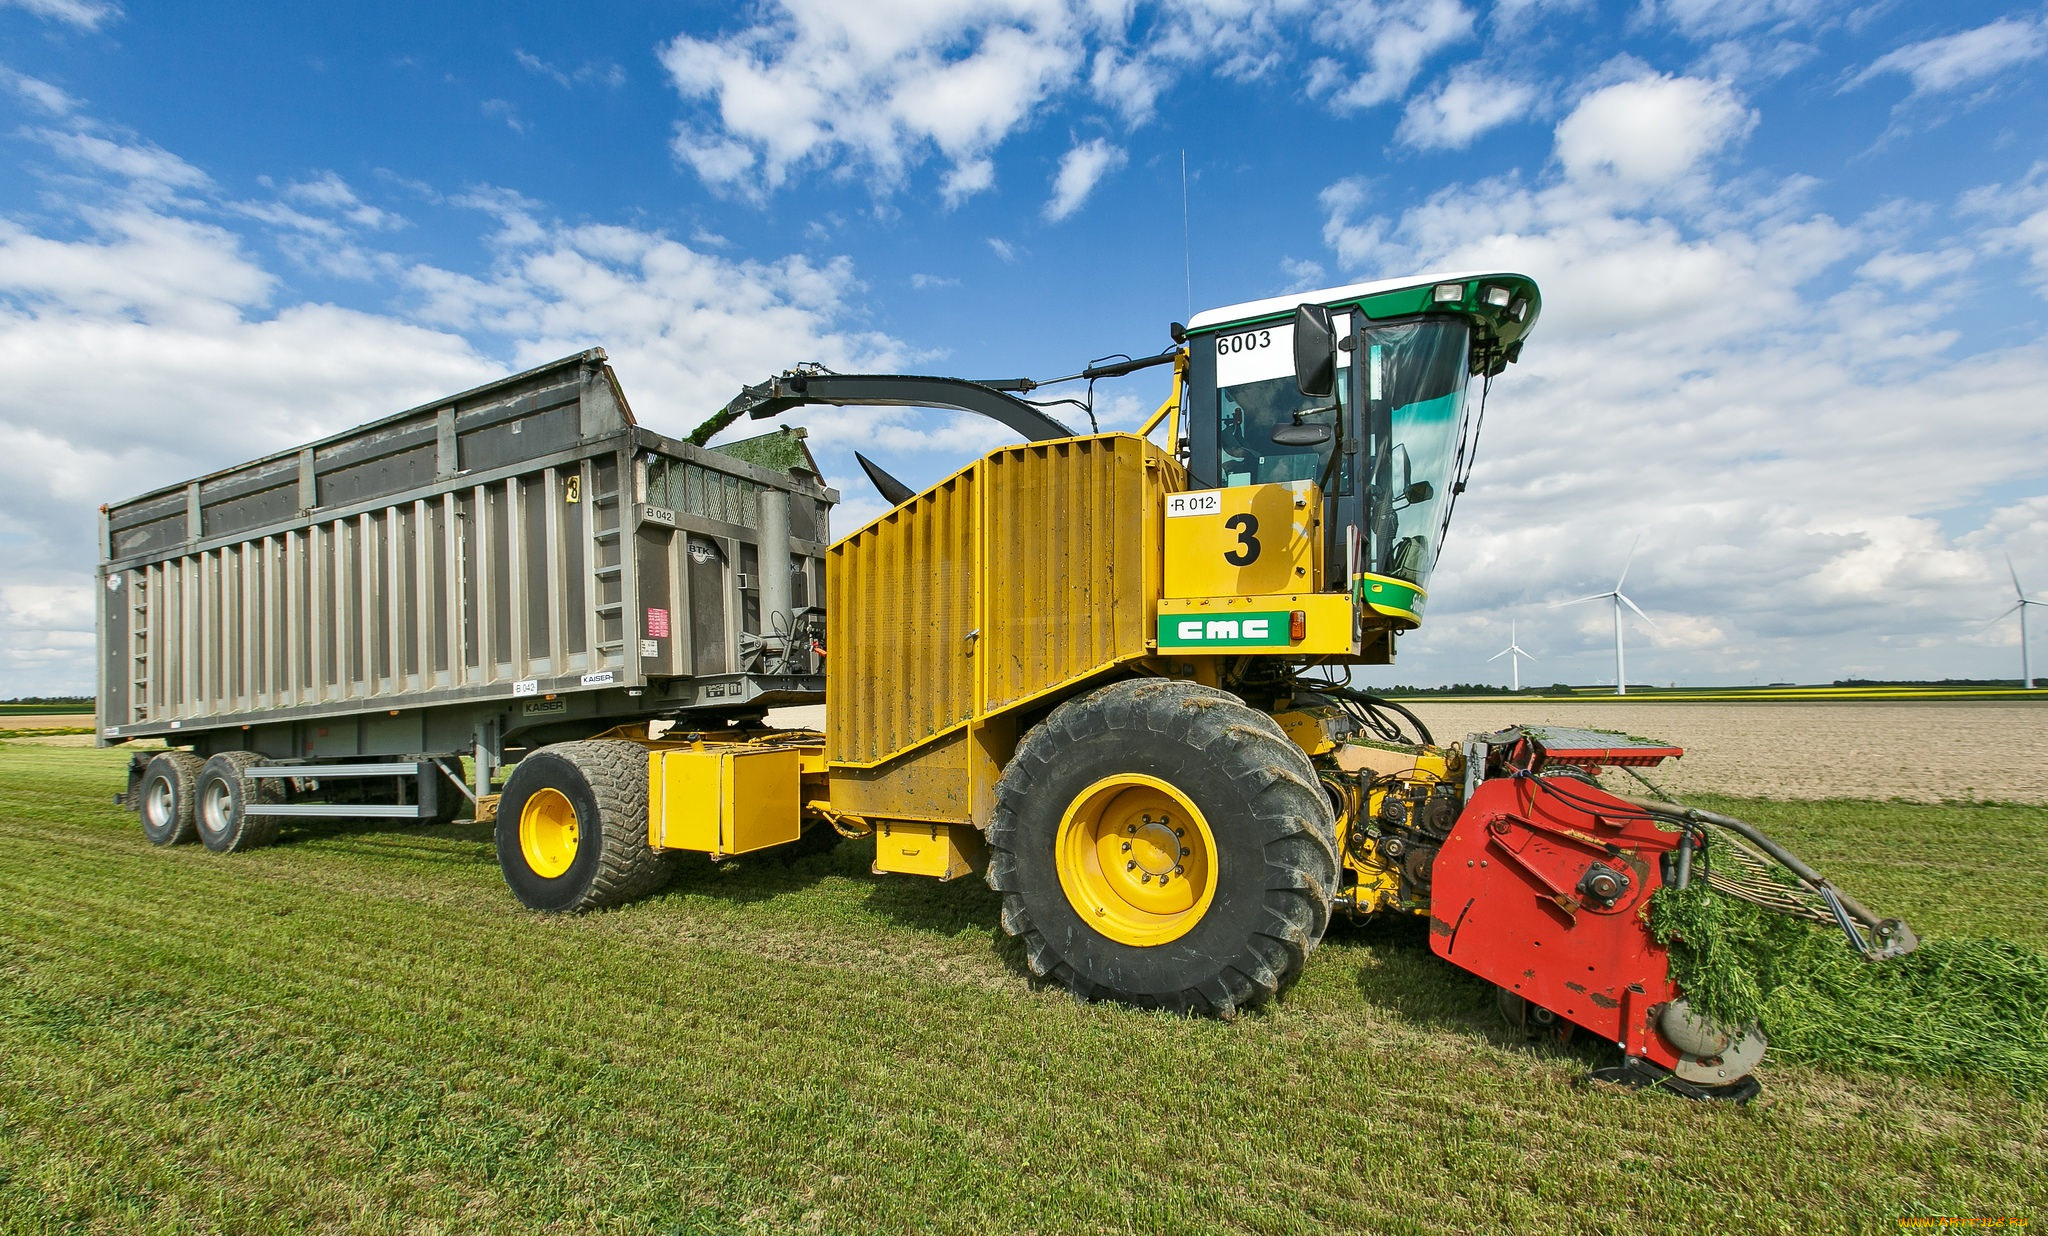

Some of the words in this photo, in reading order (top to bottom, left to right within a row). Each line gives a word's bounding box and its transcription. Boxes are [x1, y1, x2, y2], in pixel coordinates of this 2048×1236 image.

[1217, 330, 1271, 355] 6003
[1223, 513, 1261, 567] 3
[689, 545, 710, 555] BTK
[583, 674, 611, 683] KAISER
[525, 701, 563, 713] KAISER
